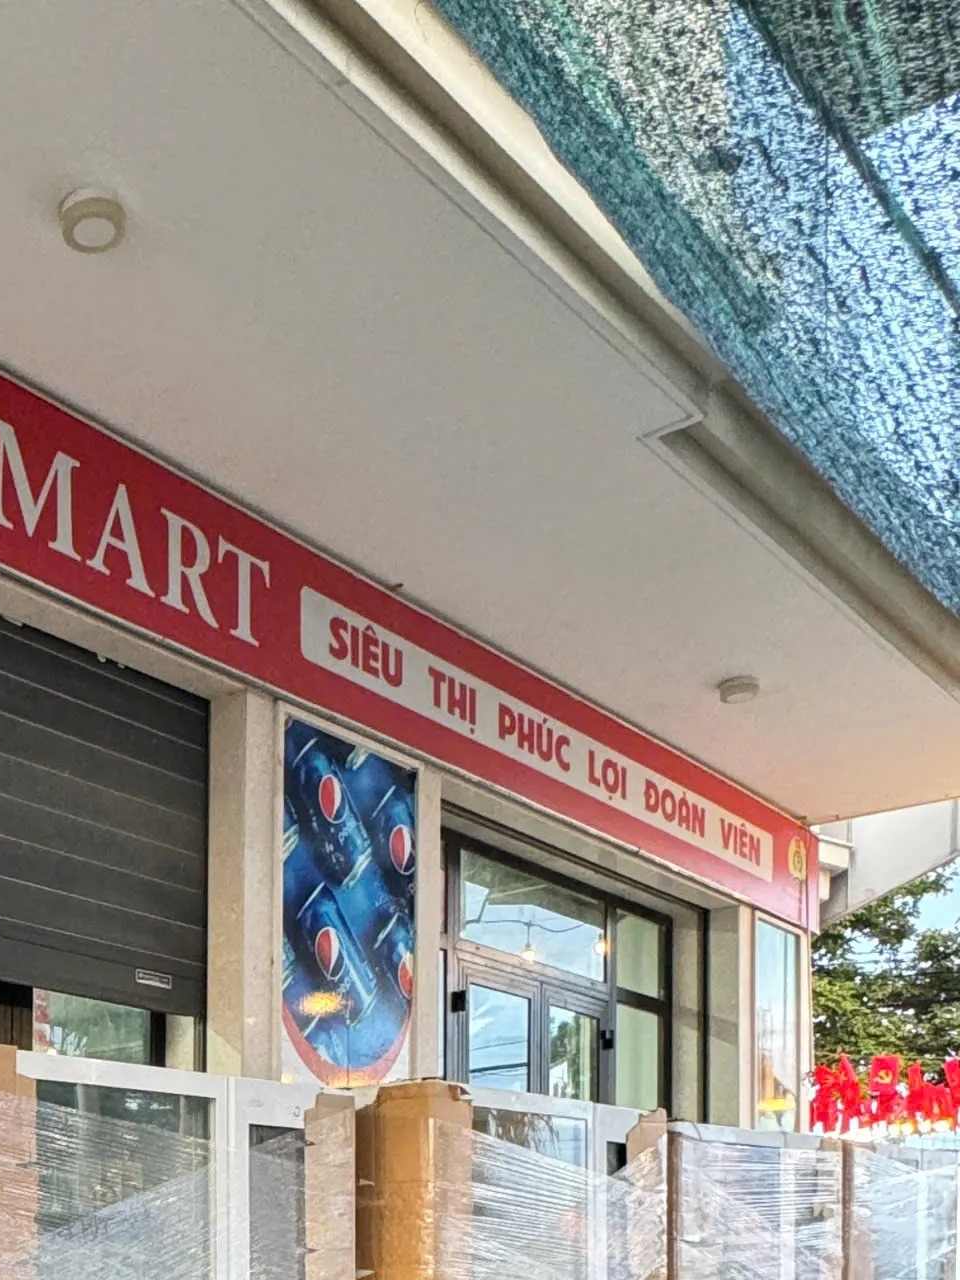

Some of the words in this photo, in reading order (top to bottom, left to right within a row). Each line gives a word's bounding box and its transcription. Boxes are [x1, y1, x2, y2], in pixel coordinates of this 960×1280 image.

[328, 616, 403, 687] SIÊU
[428, 665, 477, 735] THỊ
[498, 705, 571, 772] PHÚC
[588, 749, 627, 801] LỢI
[644, 777, 706, 838] ĐOÀN
[720, 815, 761, 867] VIÊN
